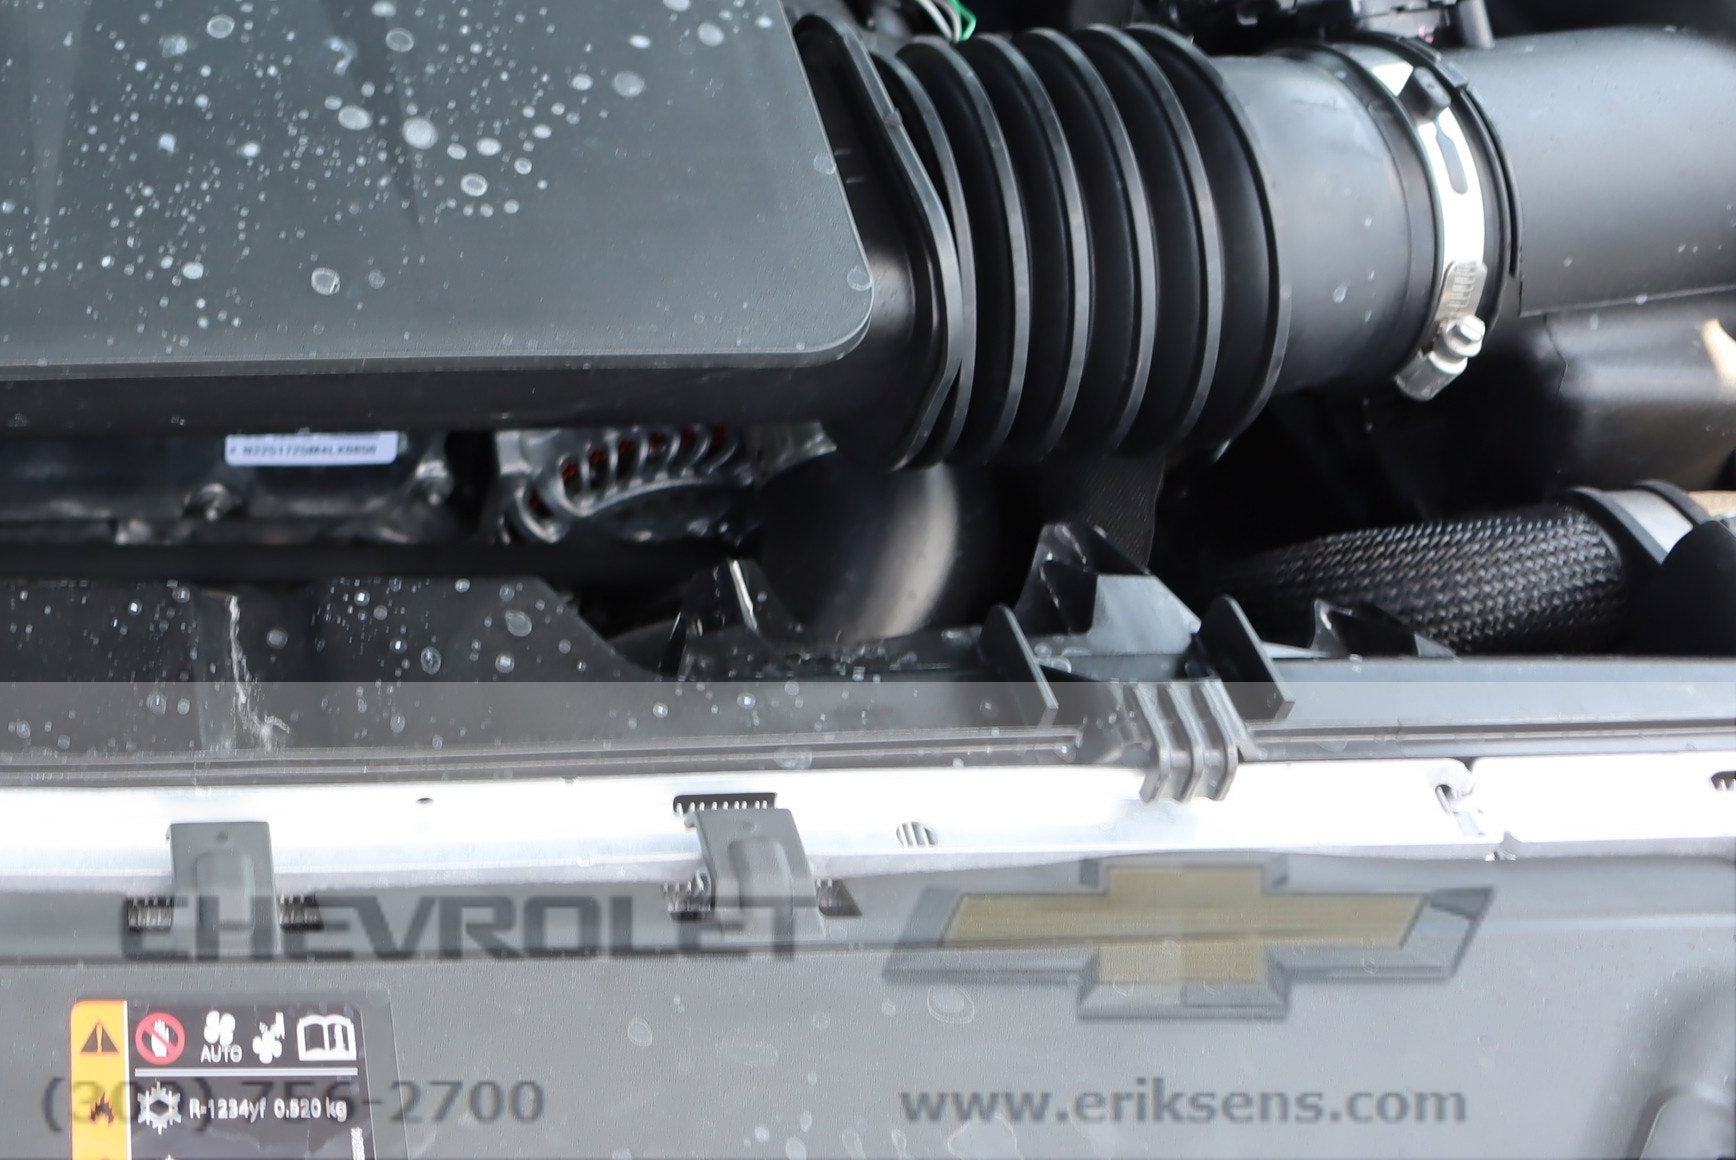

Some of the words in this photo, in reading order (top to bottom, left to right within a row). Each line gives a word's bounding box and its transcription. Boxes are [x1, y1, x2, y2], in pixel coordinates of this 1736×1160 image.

[200, 1044, 243, 1064] AUTO
[188, 1097, 267, 1123] R-1234yf
[325, 1095, 348, 1123] kg
